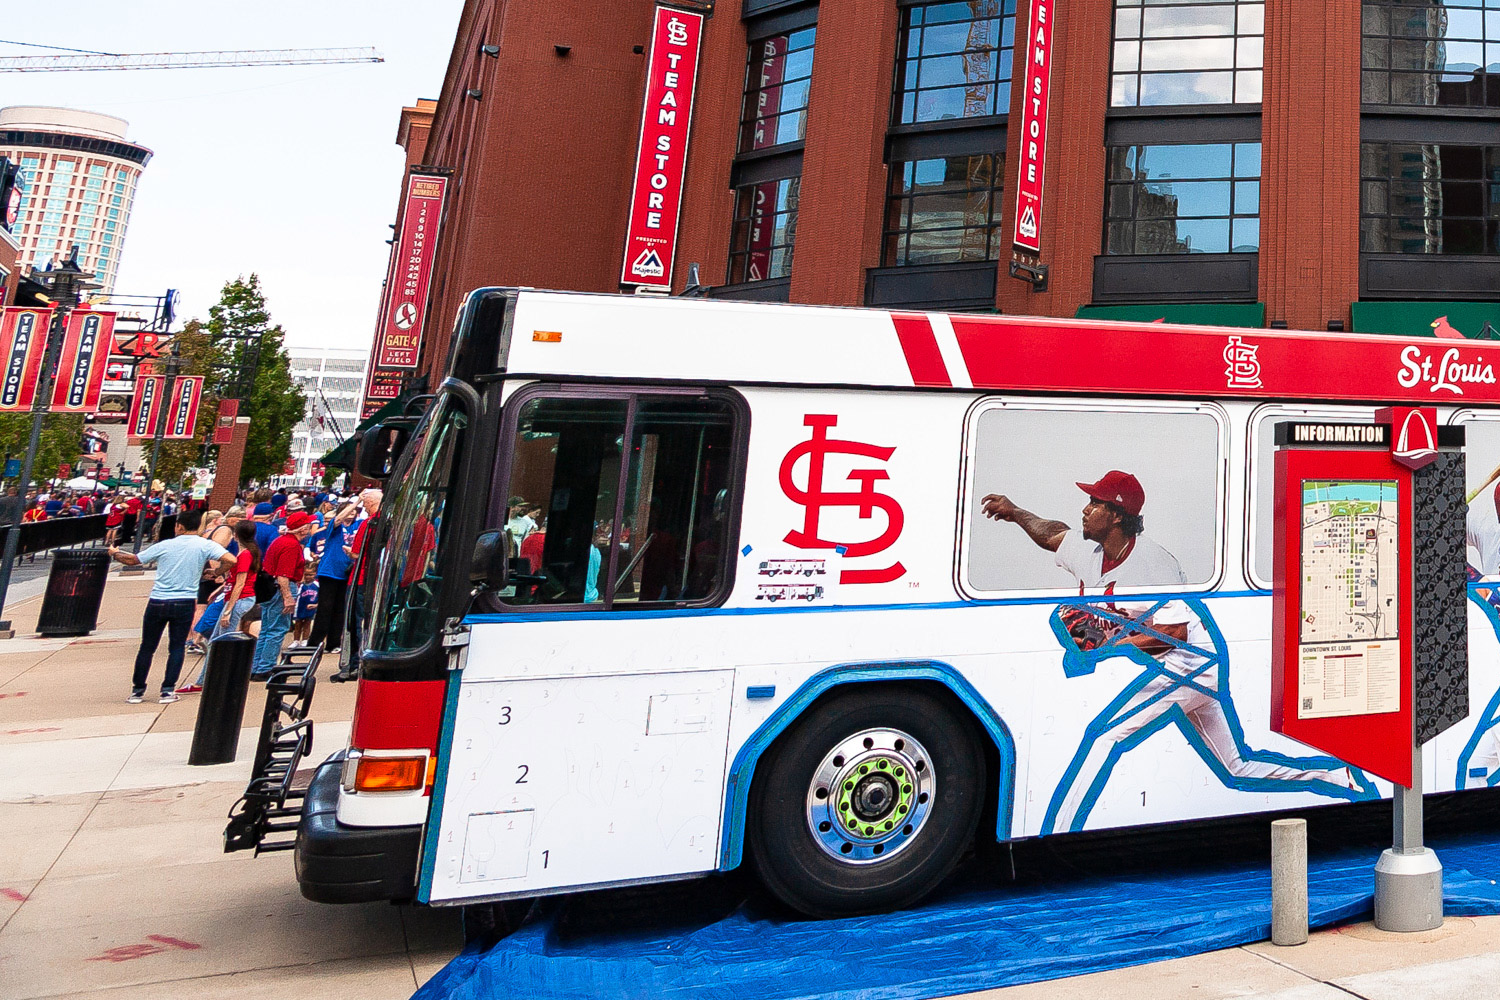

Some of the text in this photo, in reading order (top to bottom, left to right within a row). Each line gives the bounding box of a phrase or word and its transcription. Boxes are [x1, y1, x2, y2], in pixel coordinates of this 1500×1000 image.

[646, 52, 683, 229] TEAM STORE
[1027, 77, 1042, 184] STORE
[415, 232, 425, 240] 10
[634, 267, 661, 275] Majestic
[404, 288, 416, 296] 85
[386, 334, 418, 347] GATE 4
[5, 315, 32, 402] TEAM STORE
[72, 318, 97, 404] TEAM STORE
[1397, 345, 1437, 388] St.
[1430, 347, 1497, 395] Louis
[138, 380, 153, 433] TEAM STORE
[176, 406, 186, 434] STORE
[1294, 424, 1384, 443] INFORMATION
[498, 705, 512, 726] 3
[514, 764, 530, 785] 2
[1140, 791, 1147, 807] 1
[541, 849, 550, 870] 1
